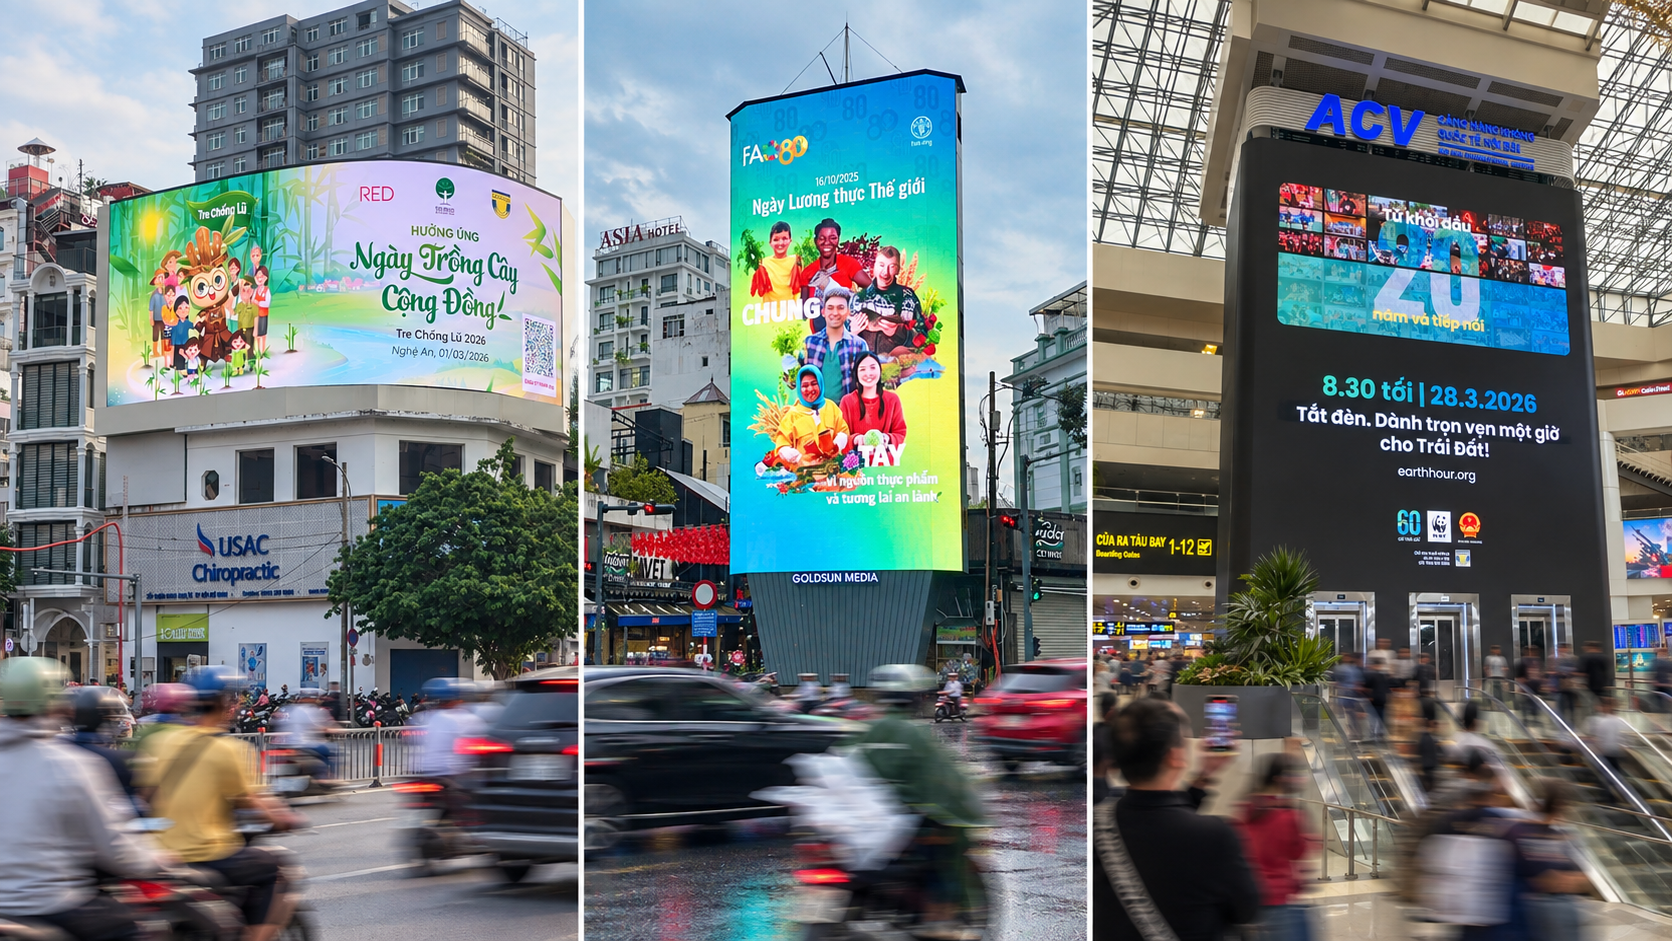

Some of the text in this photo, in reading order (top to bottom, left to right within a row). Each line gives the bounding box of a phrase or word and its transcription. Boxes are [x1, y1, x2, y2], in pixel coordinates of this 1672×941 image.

[1304, 93, 1425, 147] ACV
[815, 171, 859, 187] 16/10/2025
[359, 185, 395, 202] RED
[752, 176, 926, 218] Ngày Lương thực Thế giới
[197, 209, 210, 220] Tre
[600, 224, 644, 249] ASIA
[350, 241, 519, 295] Ngày Trồng Cây
[1373, 218, 1481, 322] 20
[381, 284, 498, 330] Cộng Đồng
[741, 297, 822, 327] CHUNG
[396, 328, 412, 339] Tre
[414, 329, 449, 344] Chống
[464, 333, 486, 346] 2026
[391, 345, 490, 363] Nghệ An, 01/03/2026
[1322, 375, 1376, 400] 8.30
[1381, 376, 1413, 403] tối
[1430, 385, 1538, 414] 28.3.2026
[1296, 403, 1560, 444] Tắt đèn. Dành trọn vẹn một giờ
[858, 443, 906, 468] TAY
[1380, 435, 1490, 458] cho Trái Đất!
[876, 473, 904, 488] thực
[1397, 466, 1477, 484] earthhour.org
[894, 493, 910, 503] an
[219, 534, 270, 558] USAC
[1116, 535, 1129, 547] RA
[1149, 536, 1167, 548] BAY
[1168, 538, 1195, 556] 1-12
[192, 561, 280, 587] Chiropractic
[792, 572, 879, 584] GOLDSUN MEDIA
